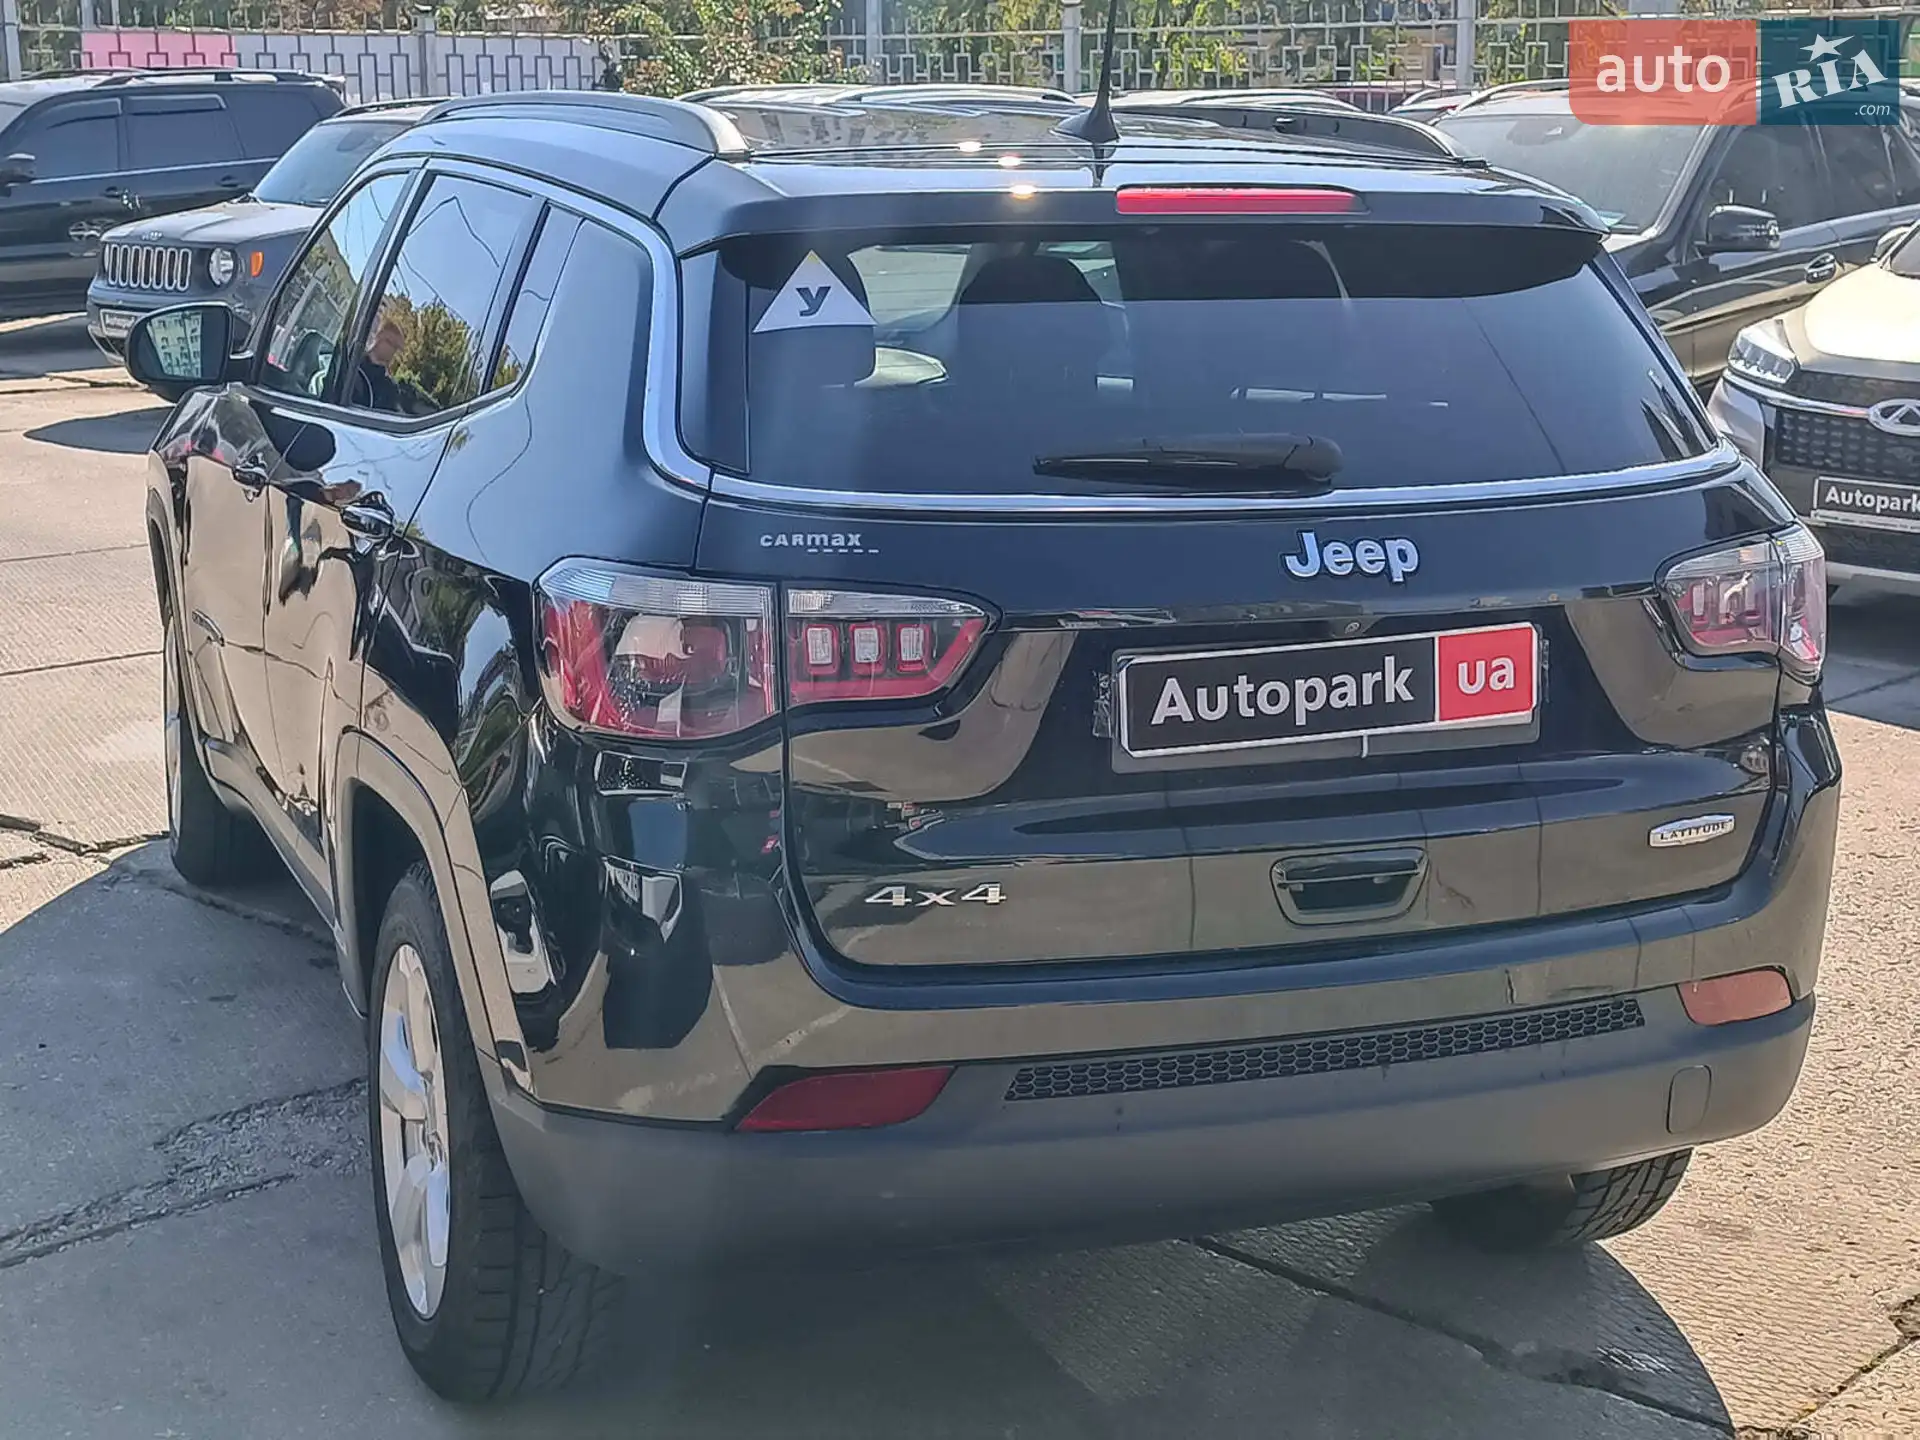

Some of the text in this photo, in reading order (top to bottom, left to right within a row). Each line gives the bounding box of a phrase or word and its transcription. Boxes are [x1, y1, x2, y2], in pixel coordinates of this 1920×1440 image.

[1285, 531, 1418, 582] Jeep
[1151, 655, 1515, 726] Autopark ua
[1660, 819, 1732, 840] LATITUDE
[865, 883, 1007, 906] 4x4
